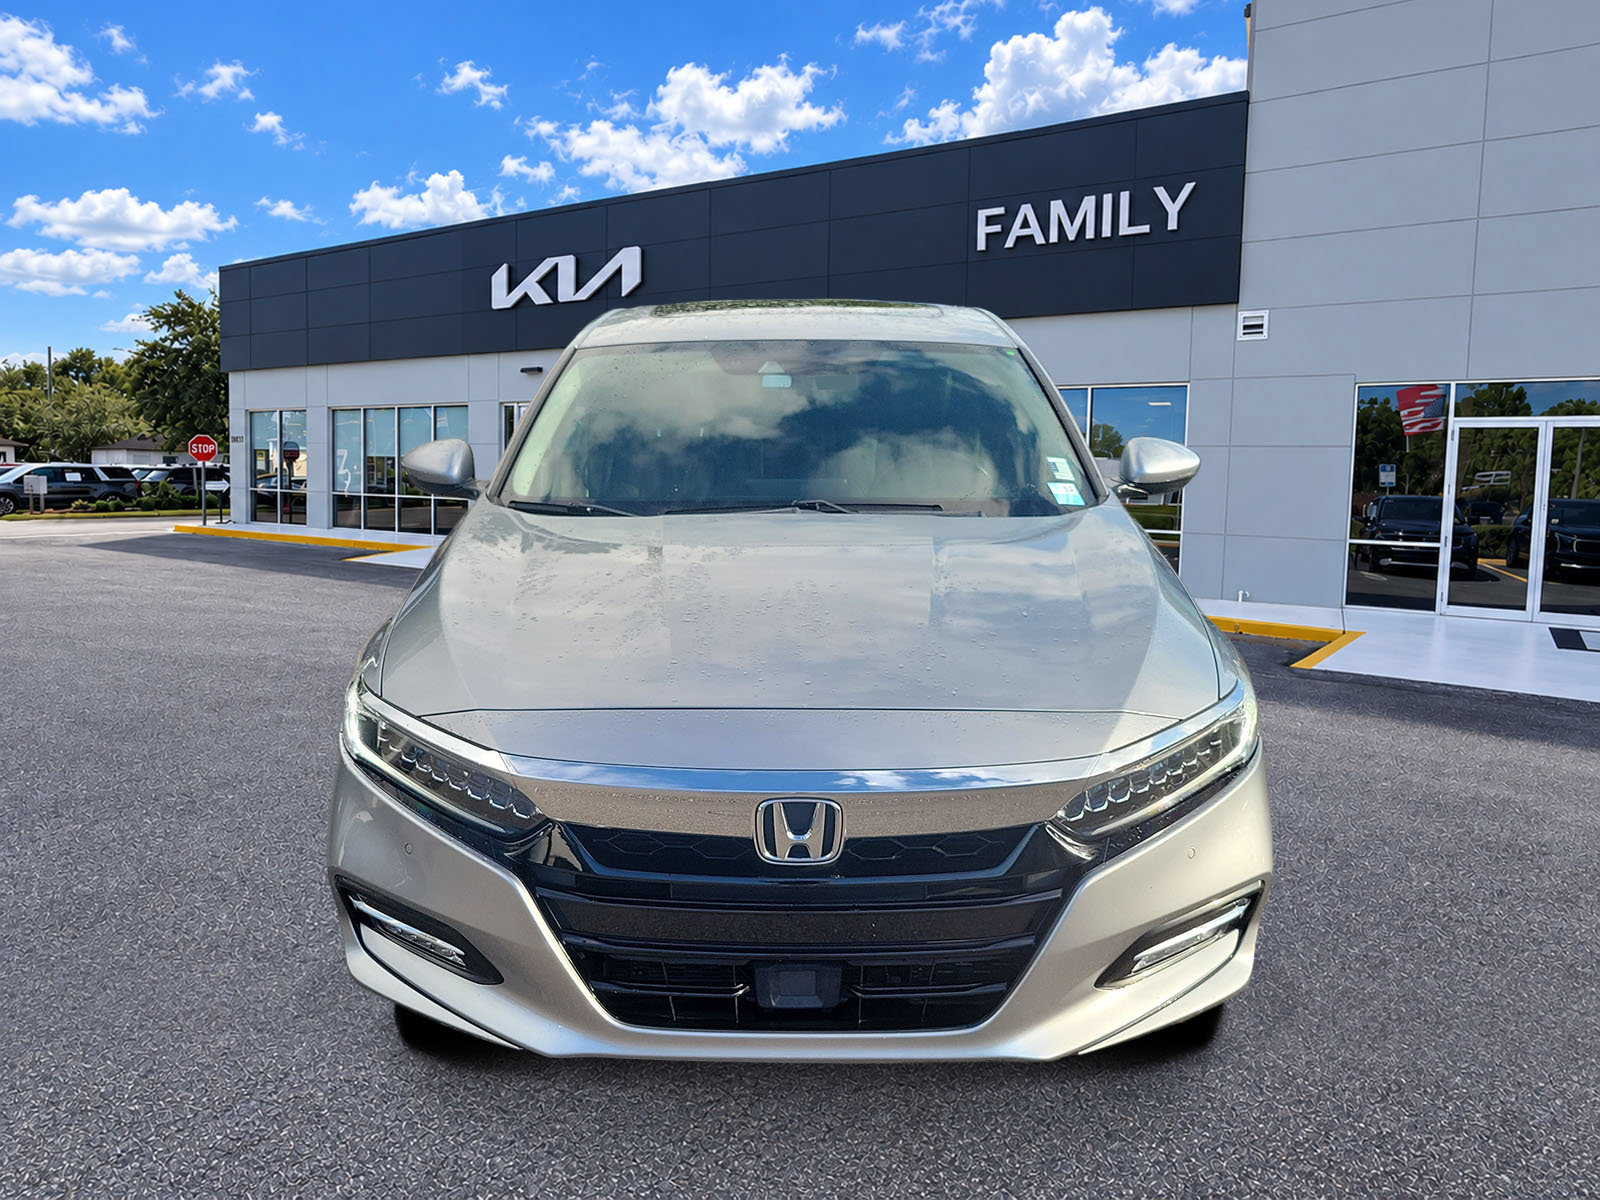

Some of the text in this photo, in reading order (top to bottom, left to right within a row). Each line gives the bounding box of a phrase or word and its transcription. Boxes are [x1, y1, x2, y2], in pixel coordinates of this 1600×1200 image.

[976, 182, 1196, 251] FAMILY
[491, 246, 641, 309] KIA
[191, 443, 215, 454] STOP
